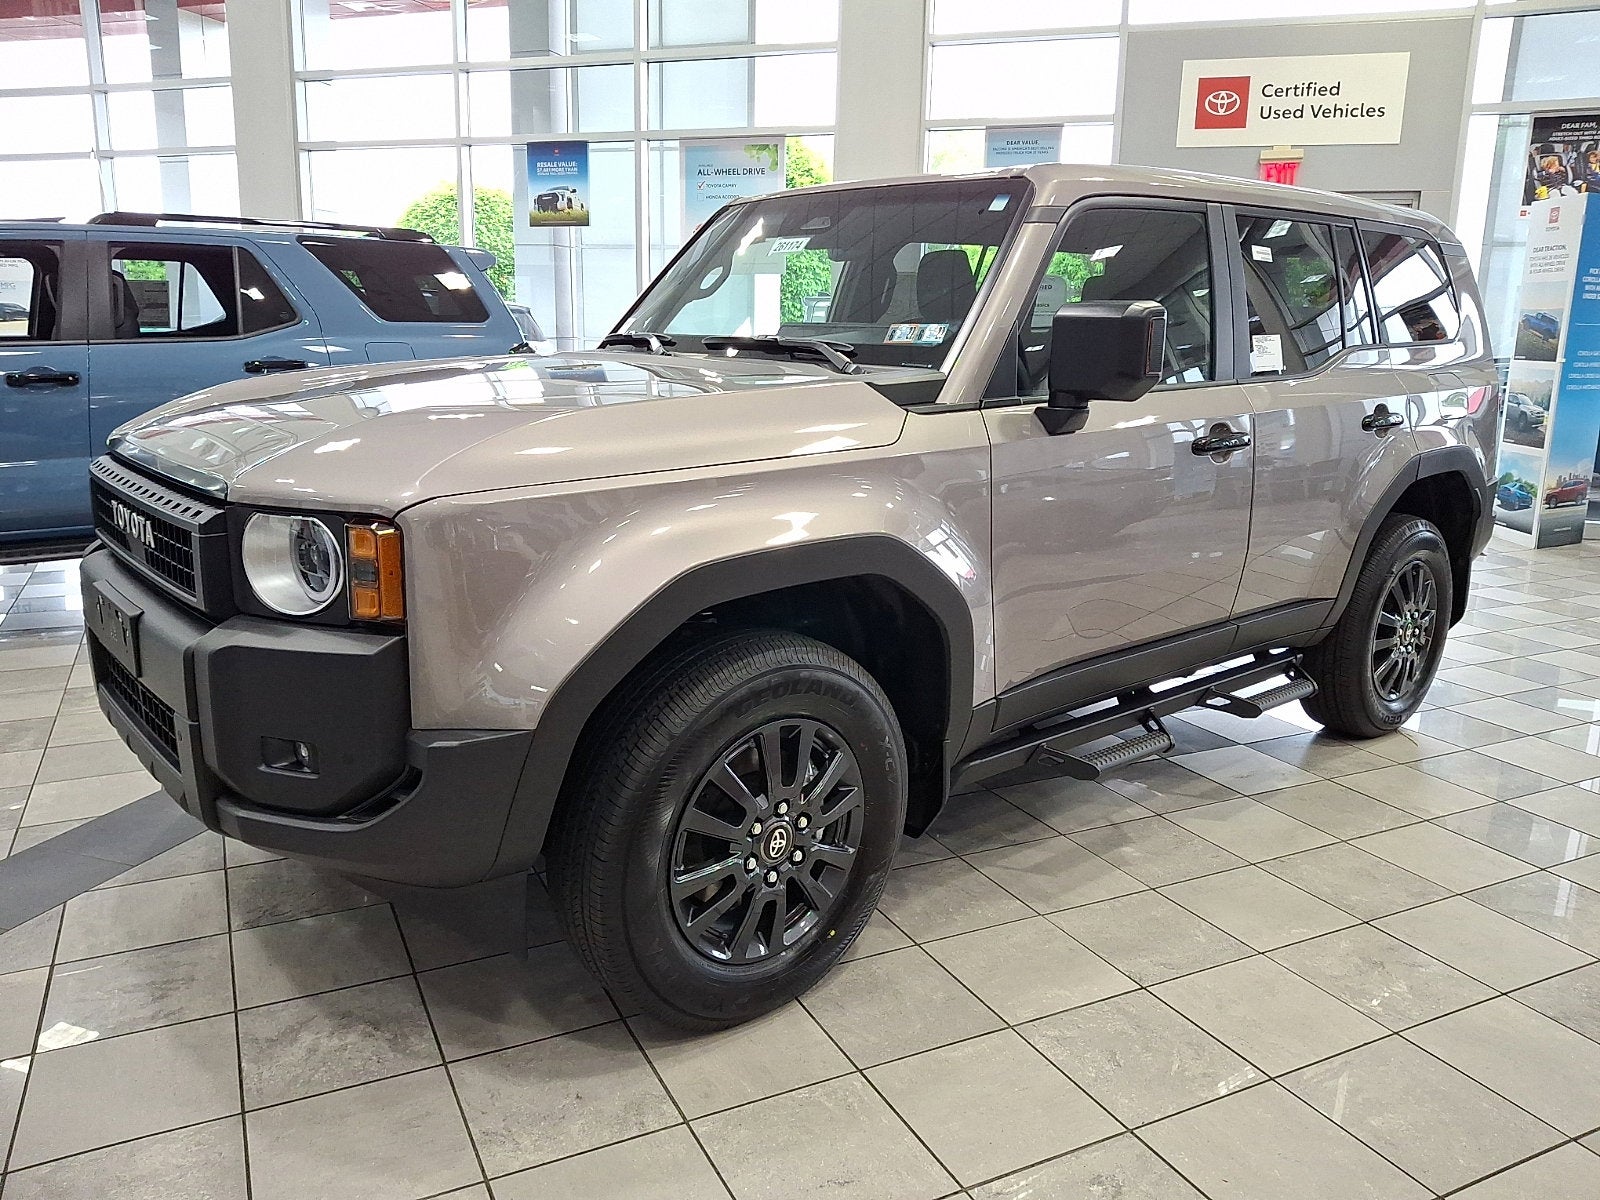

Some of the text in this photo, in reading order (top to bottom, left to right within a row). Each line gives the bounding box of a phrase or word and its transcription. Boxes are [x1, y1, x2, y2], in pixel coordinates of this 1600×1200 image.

[1261, 81, 1341, 98] Certified
[1259, 103, 1386, 120] Used Vehicles
[558, 160, 578, 168] VALUE:
[697, 167, 766, 177] ALL-WHEEL DRIVE
[1266, 163, 1297, 185] EXIT
[111, 499, 155, 549] TOYOTA
